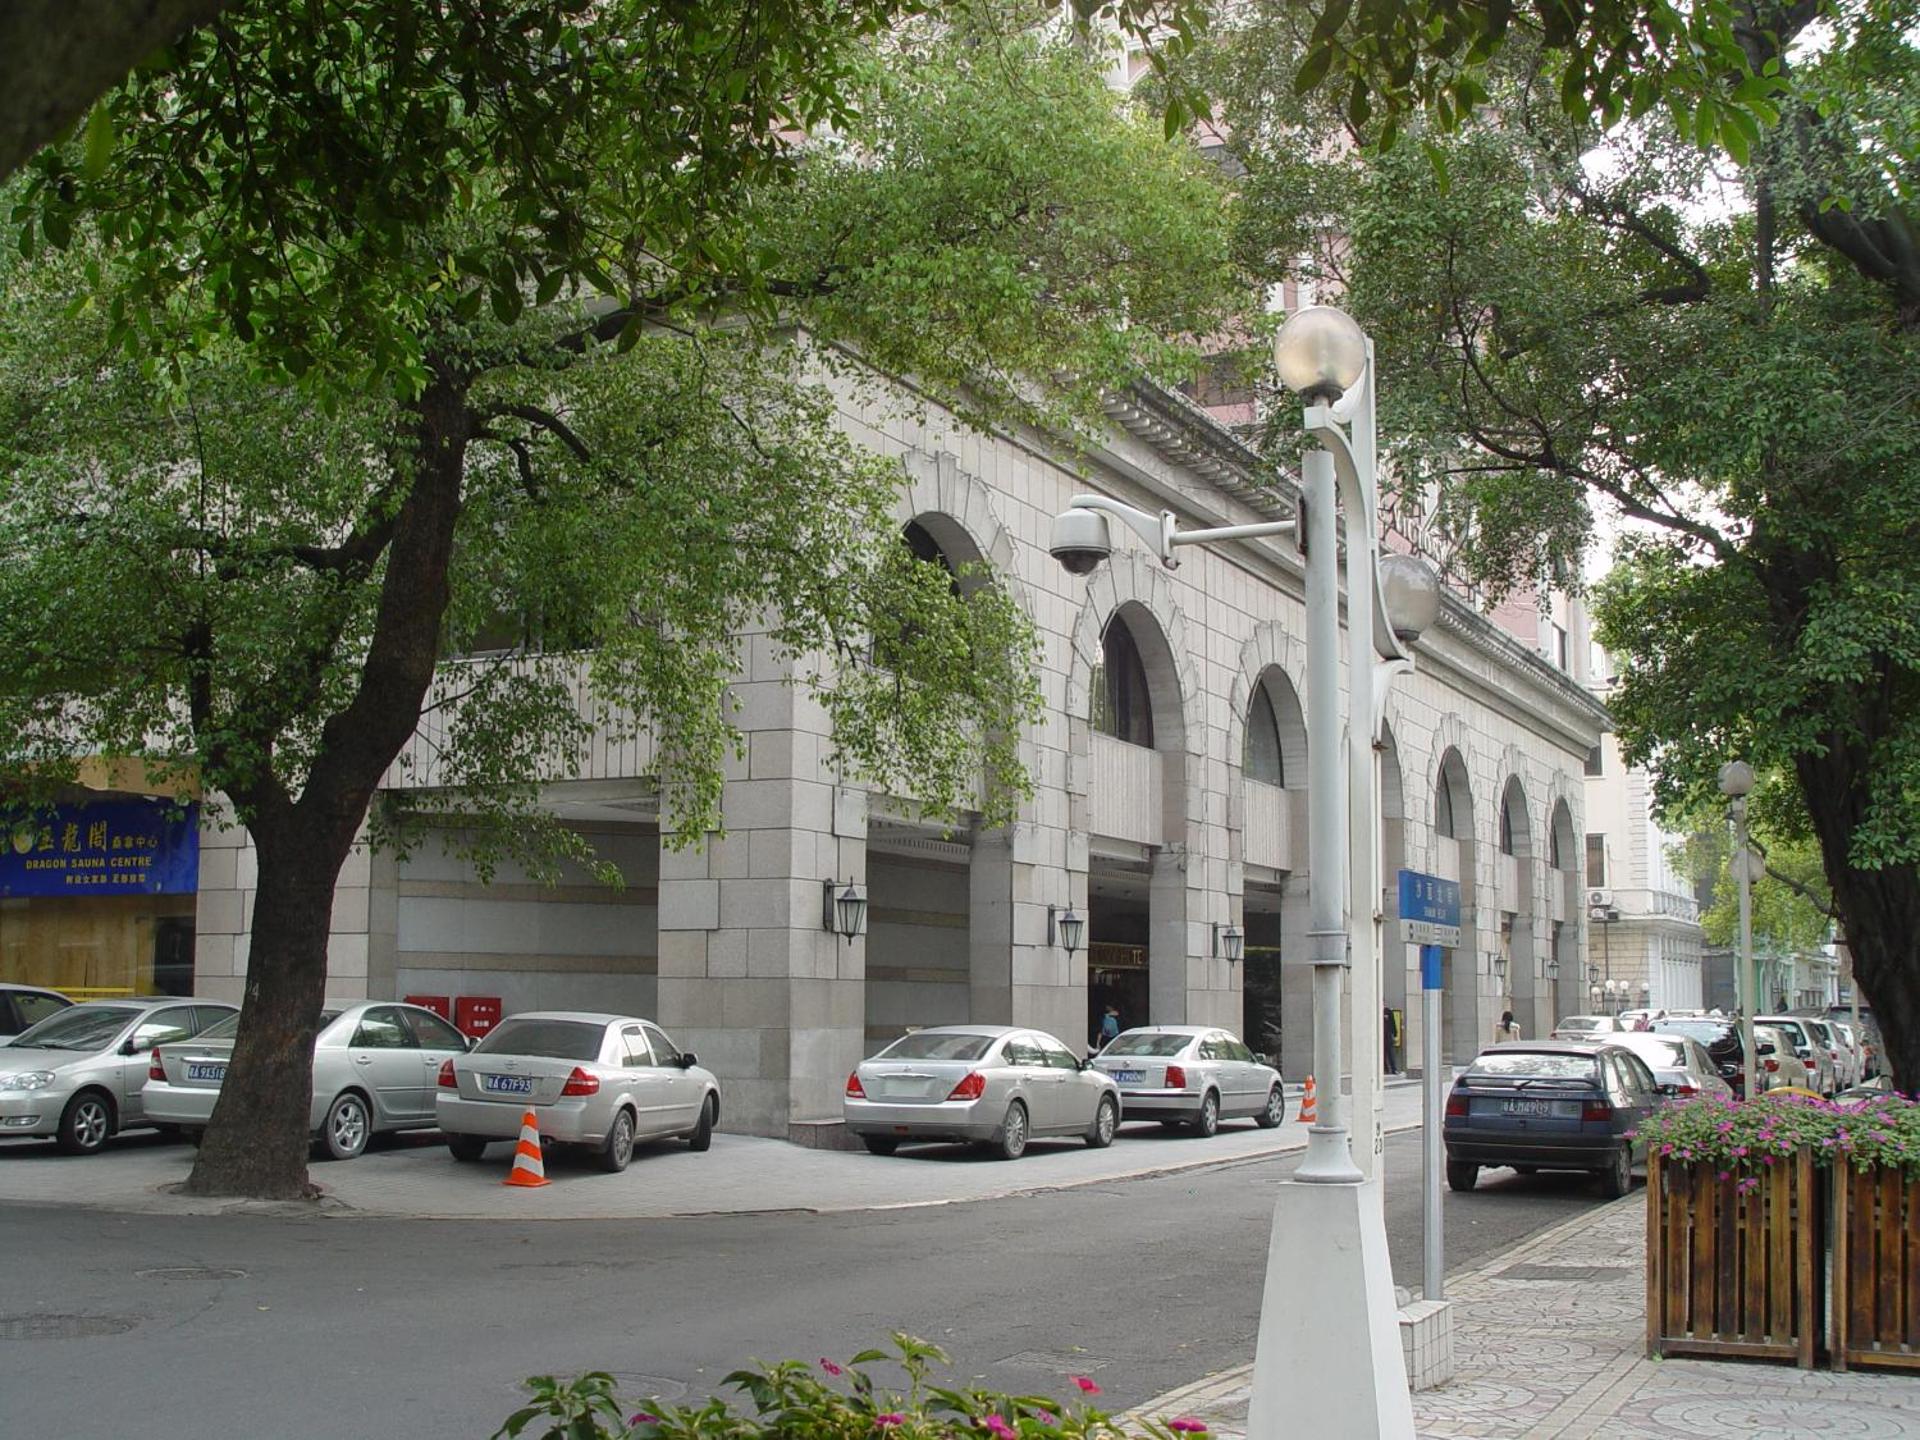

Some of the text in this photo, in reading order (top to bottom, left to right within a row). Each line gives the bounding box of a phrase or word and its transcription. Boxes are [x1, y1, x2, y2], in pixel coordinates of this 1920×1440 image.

[26, 856, 152, 870] DRAGON SAUNA CENTRE
